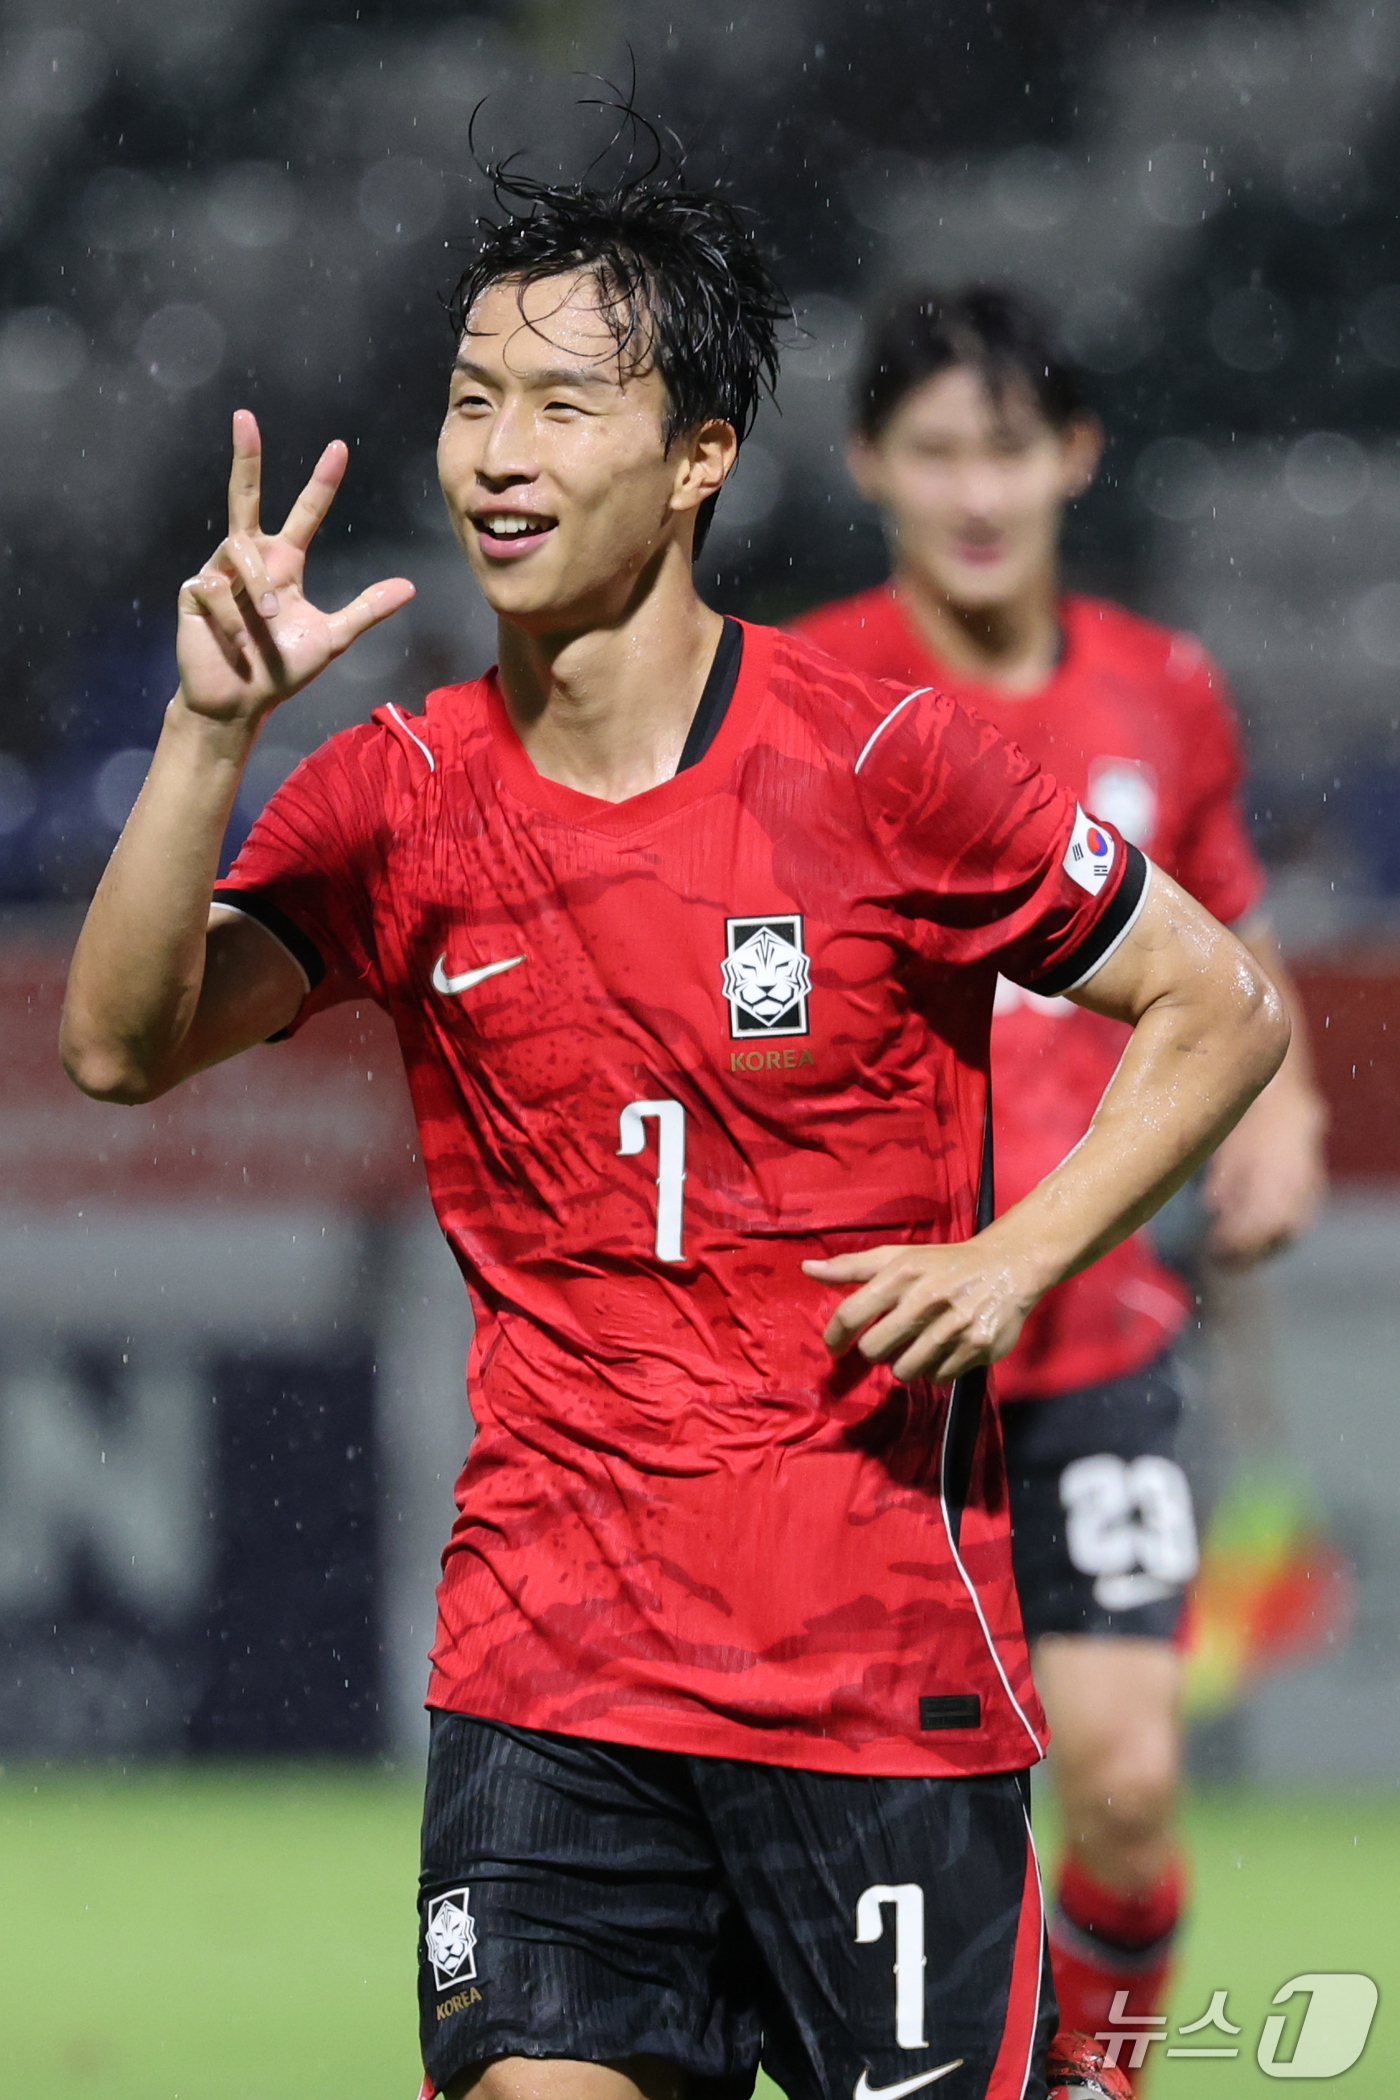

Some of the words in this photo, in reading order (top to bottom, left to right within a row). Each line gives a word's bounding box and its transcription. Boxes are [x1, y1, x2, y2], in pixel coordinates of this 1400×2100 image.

[730, 1049, 815, 1073] KOREA
[616, 1100, 688, 1262] 7
[436, 1986, 483, 2021] KOREA
[854, 1883, 929, 2050] 7
